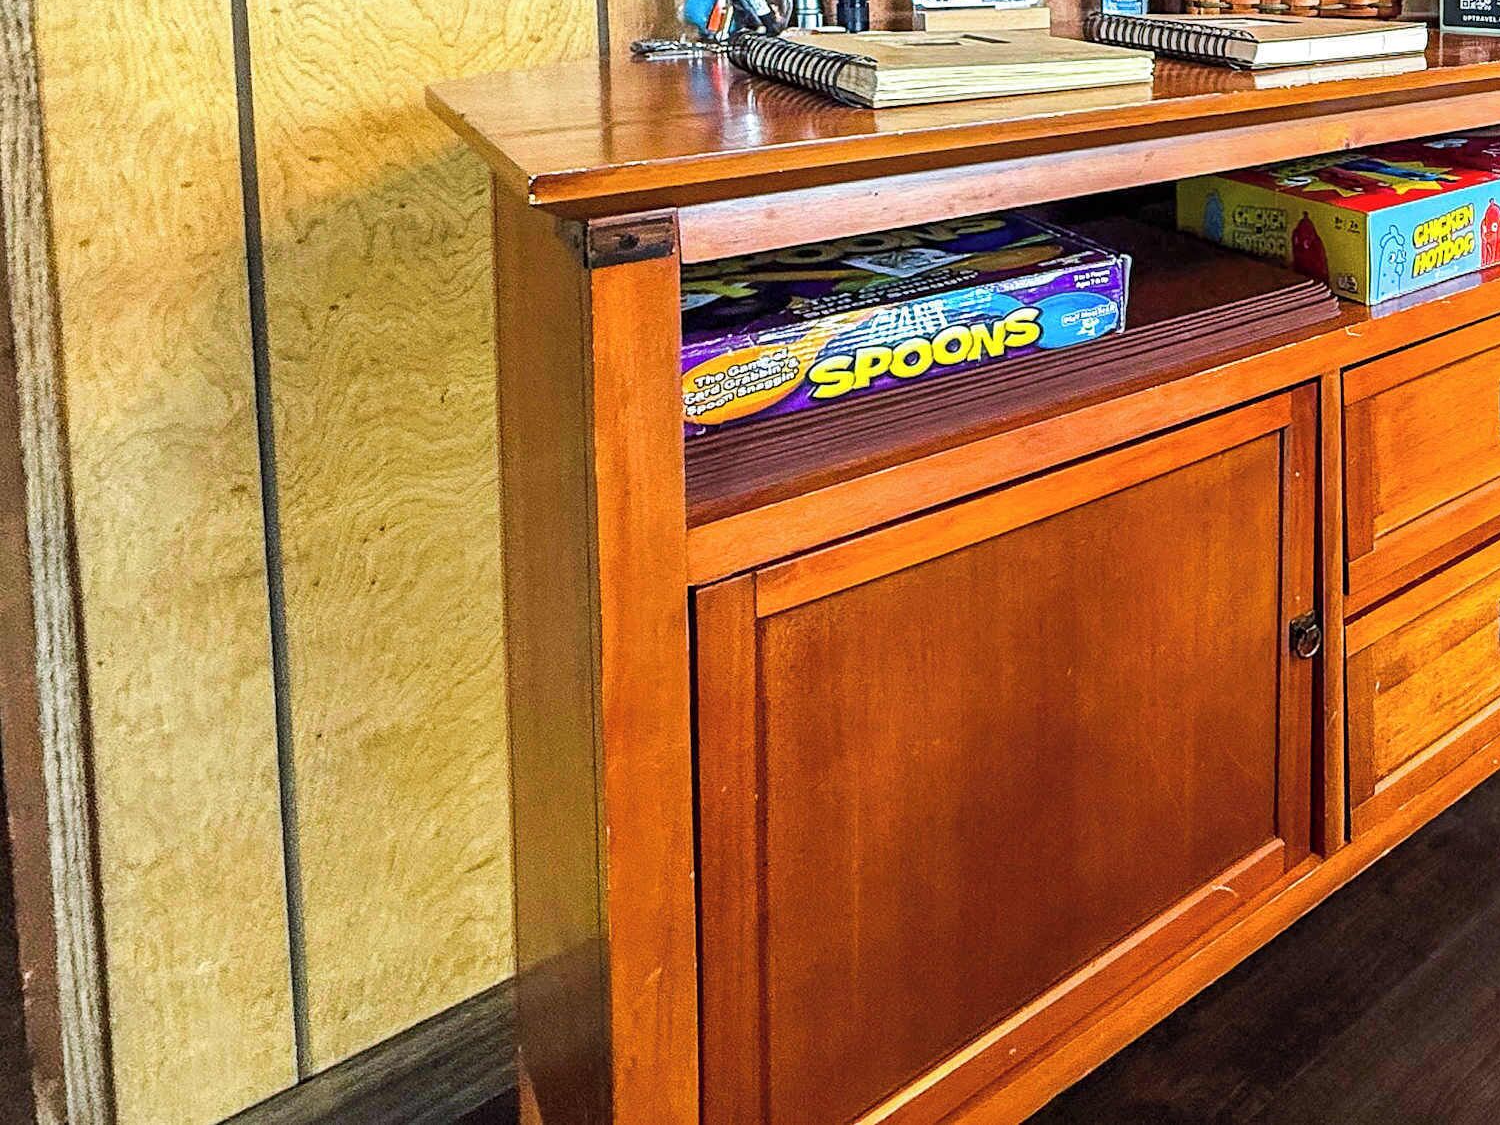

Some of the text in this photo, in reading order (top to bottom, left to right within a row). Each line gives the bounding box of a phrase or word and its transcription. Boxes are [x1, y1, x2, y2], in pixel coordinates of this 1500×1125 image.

[1413, 203, 1475, 249] CHICKEN
[1412, 231, 1475, 279] HOTDOG
[808, 307, 1042, 399] SPOONS
[683, 383, 722, 406] Card
[787, 355, 800, 370] &
[685, 367, 800, 416] Spoon Snaggin'
[694, 372, 726, 389] The
